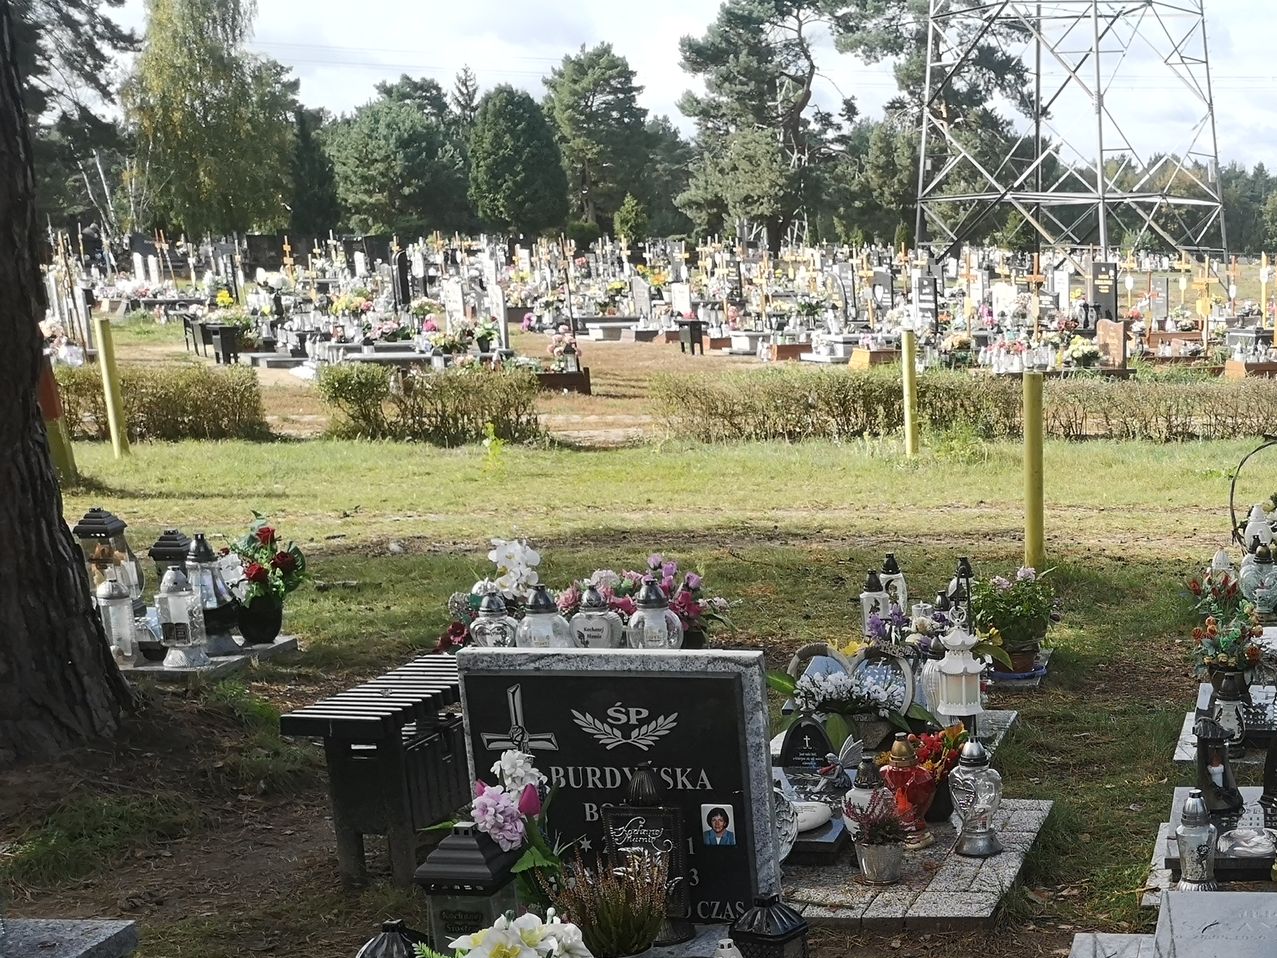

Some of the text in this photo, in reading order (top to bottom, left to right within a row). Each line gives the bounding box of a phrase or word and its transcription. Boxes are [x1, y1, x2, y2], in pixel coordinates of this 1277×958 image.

[607, 702, 649, 725] ŚP
[549, 764, 713, 790] BURDYSKA
[697, 901, 746, 919] CZAS
